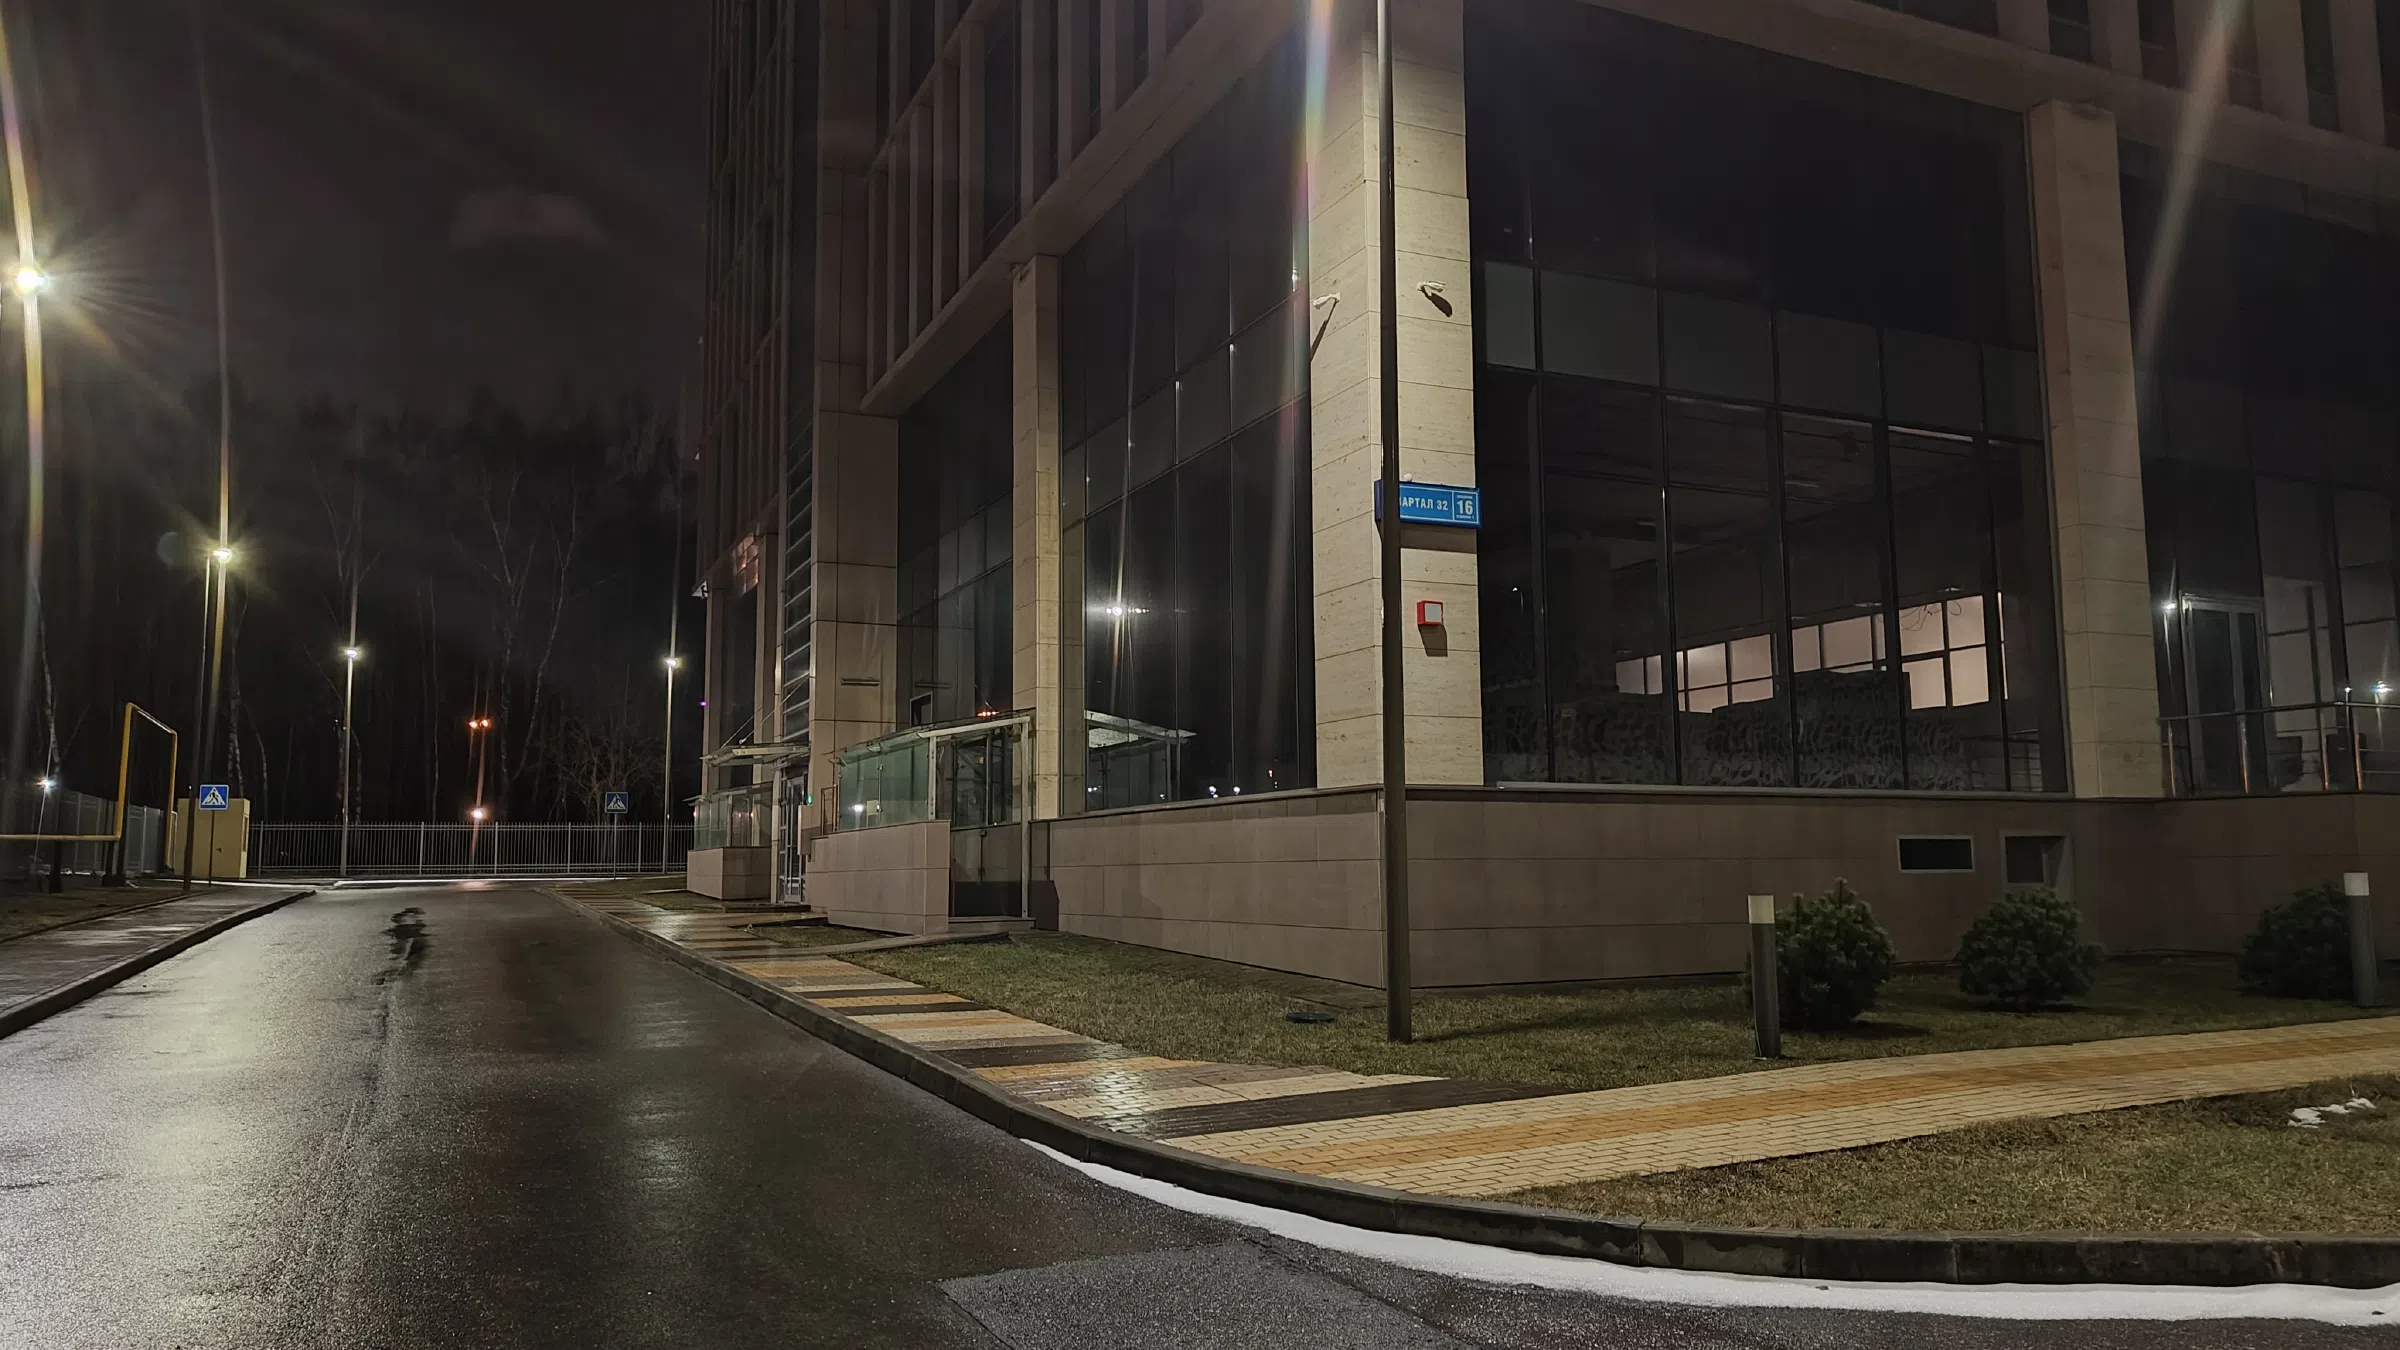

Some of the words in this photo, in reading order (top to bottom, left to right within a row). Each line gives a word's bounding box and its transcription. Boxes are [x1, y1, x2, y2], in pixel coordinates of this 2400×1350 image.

[1399, 496, 1433, 509] АРТАЛ
[1437, 500, 1448, 511] 32
[1457, 500, 1473, 515] 16
